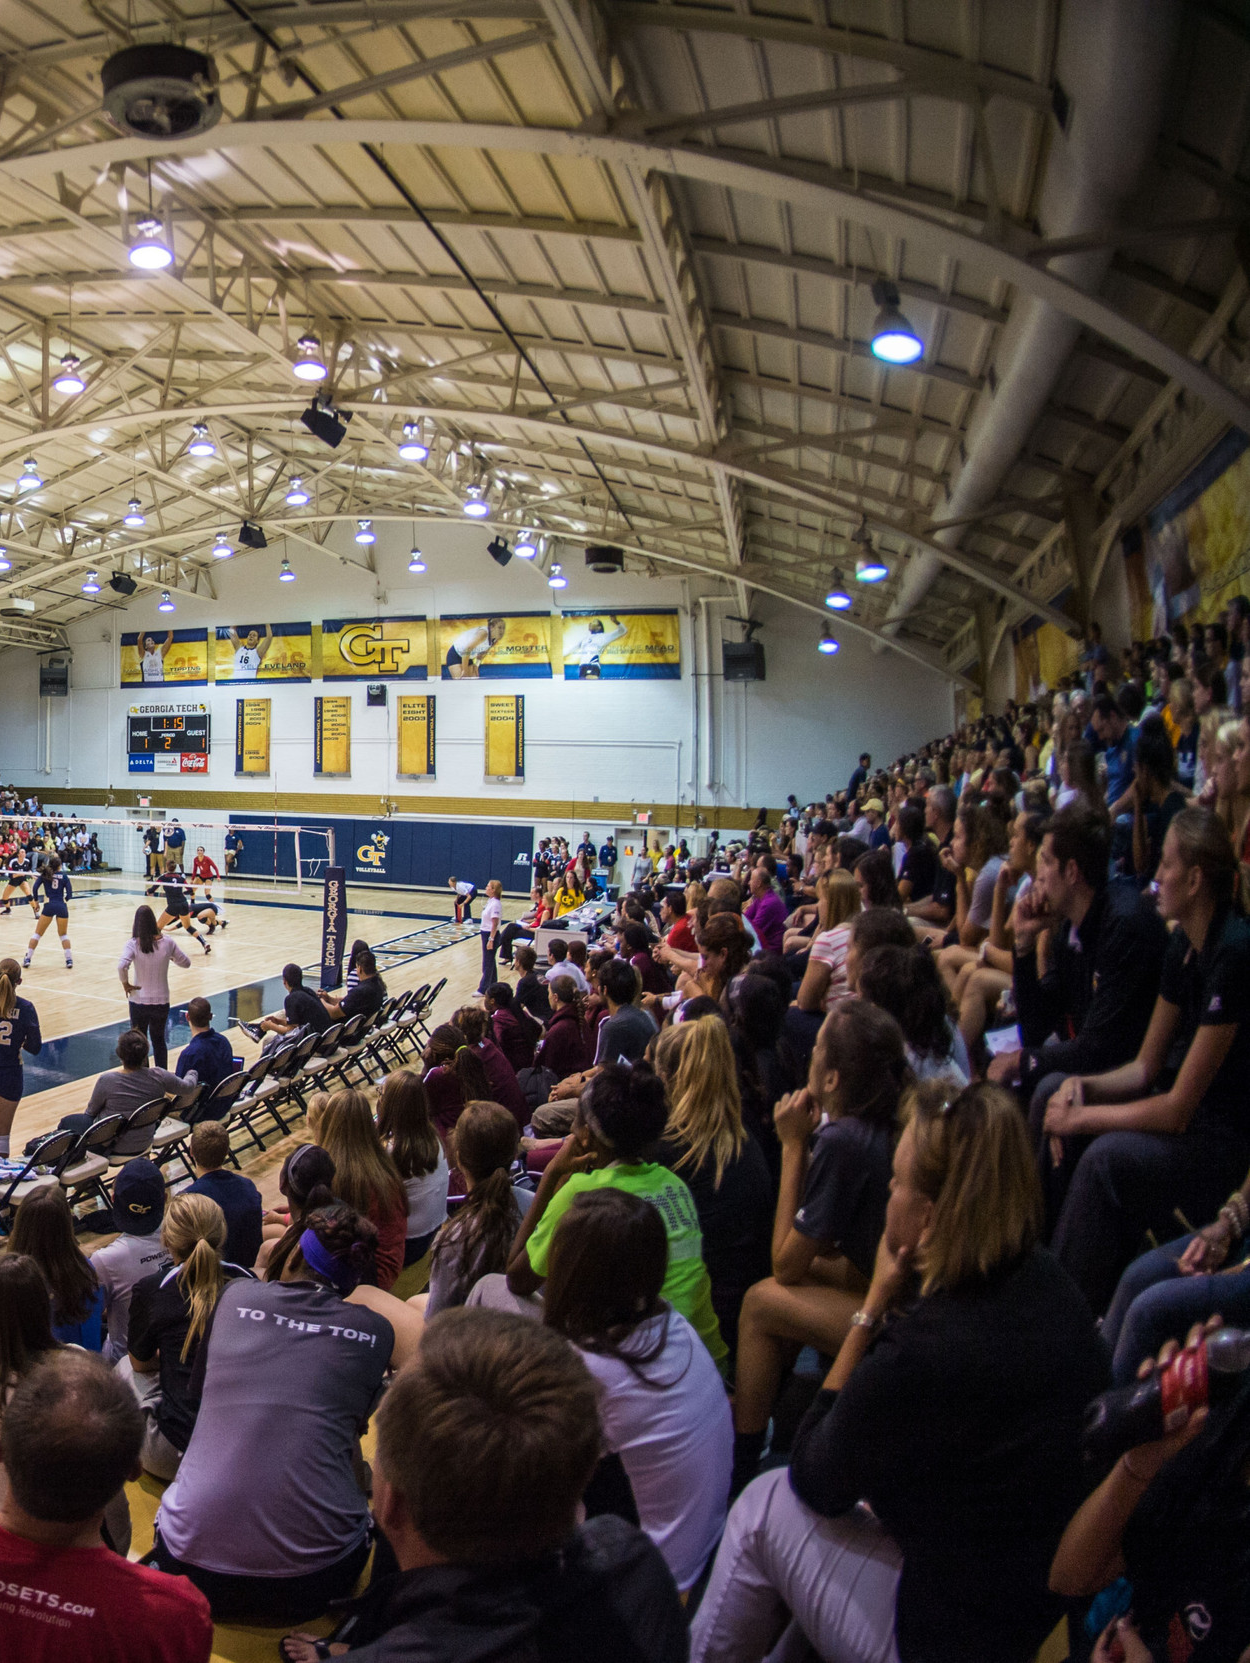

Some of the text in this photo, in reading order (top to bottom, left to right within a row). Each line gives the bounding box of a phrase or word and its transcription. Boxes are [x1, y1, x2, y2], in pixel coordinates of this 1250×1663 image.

[340, 625, 410, 672] GT
[140, 705, 174, 713] GEORGIA
[163, 717, 183, 729] 1:15
[164, 737, 172, 749] 2
[357, 844, 386, 866] GT
[325, 881, 339, 966] GEORGIA TECH
[129, 1203, 151, 1214] GT
[141, 1250, 170, 1264] POWER
[237, 1308, 376, 1348] TO THE TOP!
[18, 1604, 71, 1628] Revolution
